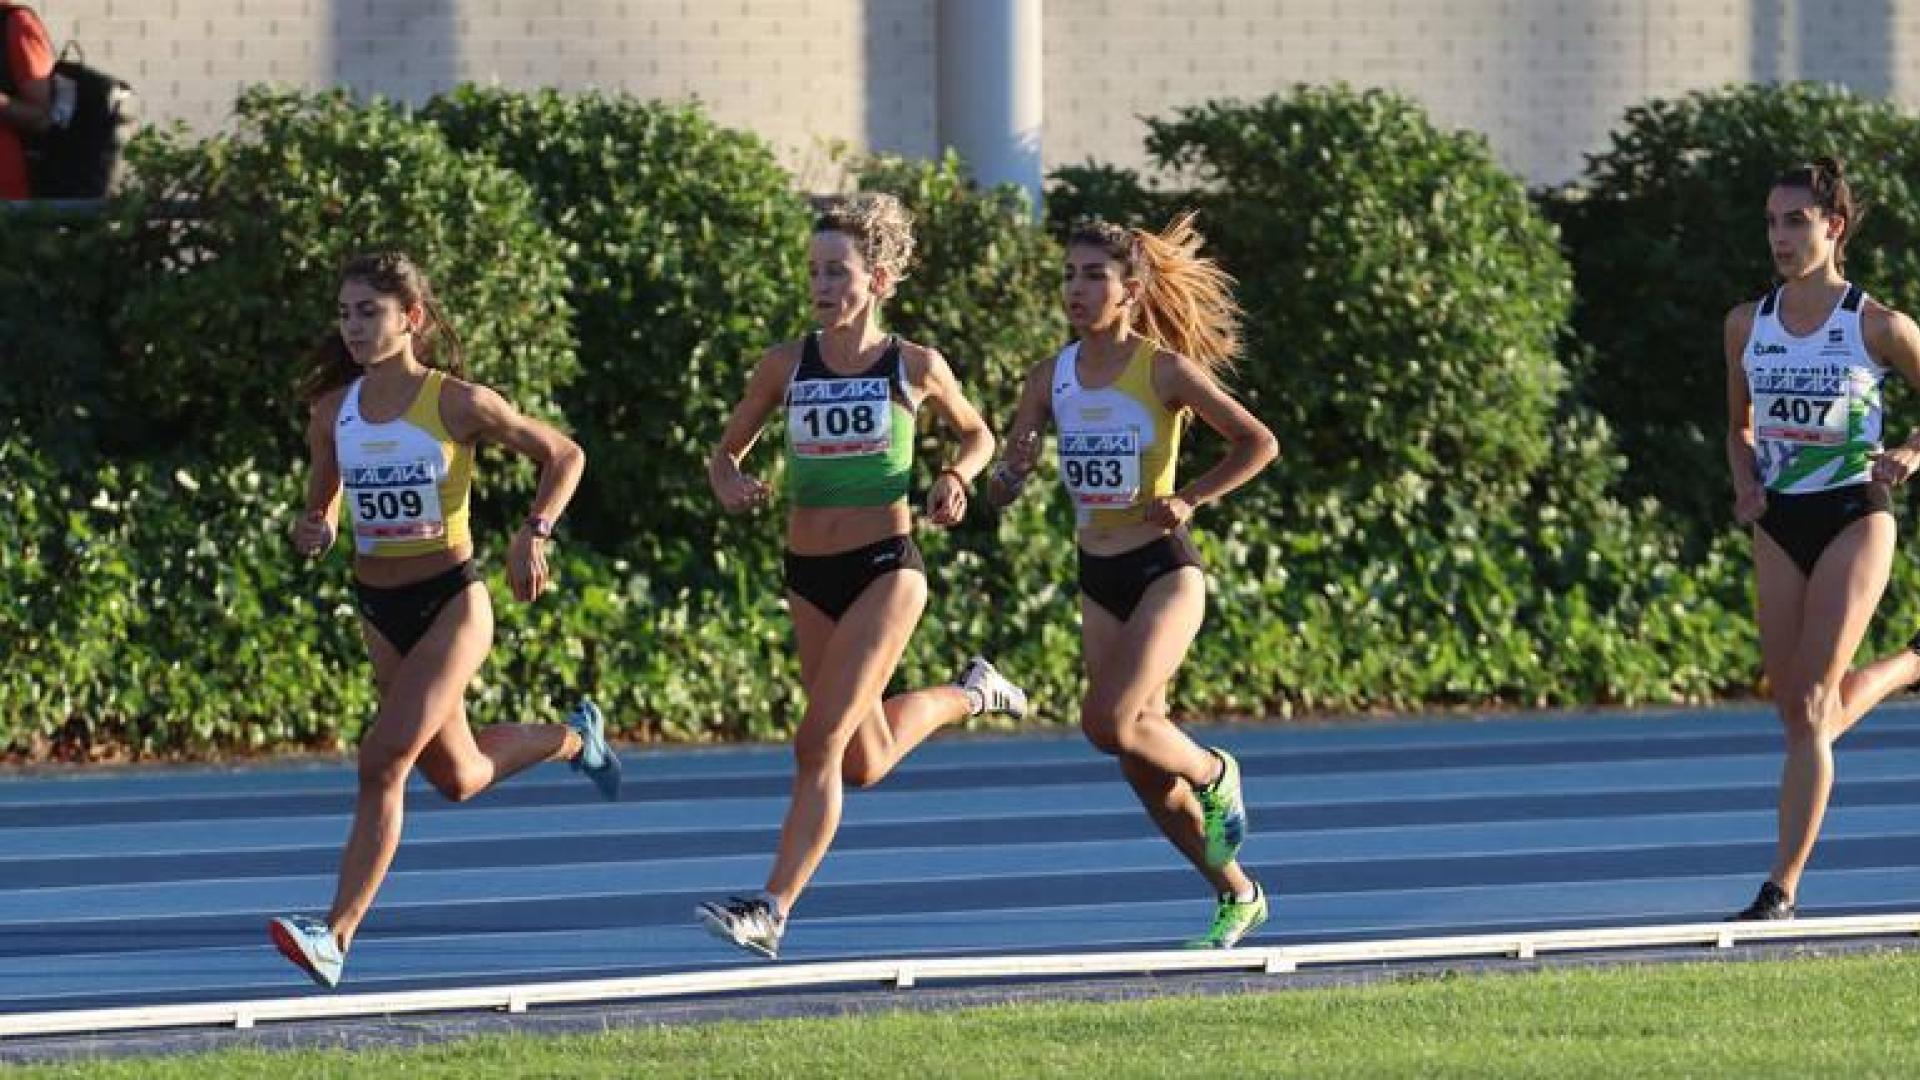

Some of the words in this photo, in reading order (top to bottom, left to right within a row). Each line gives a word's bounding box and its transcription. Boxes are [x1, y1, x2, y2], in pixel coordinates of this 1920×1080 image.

[804, 406, 874, 436] 108
[1769, 398, 1833, 426] 407
[1067, 460, 1122, 487] 963
[358, 490, 423, 520] 509
